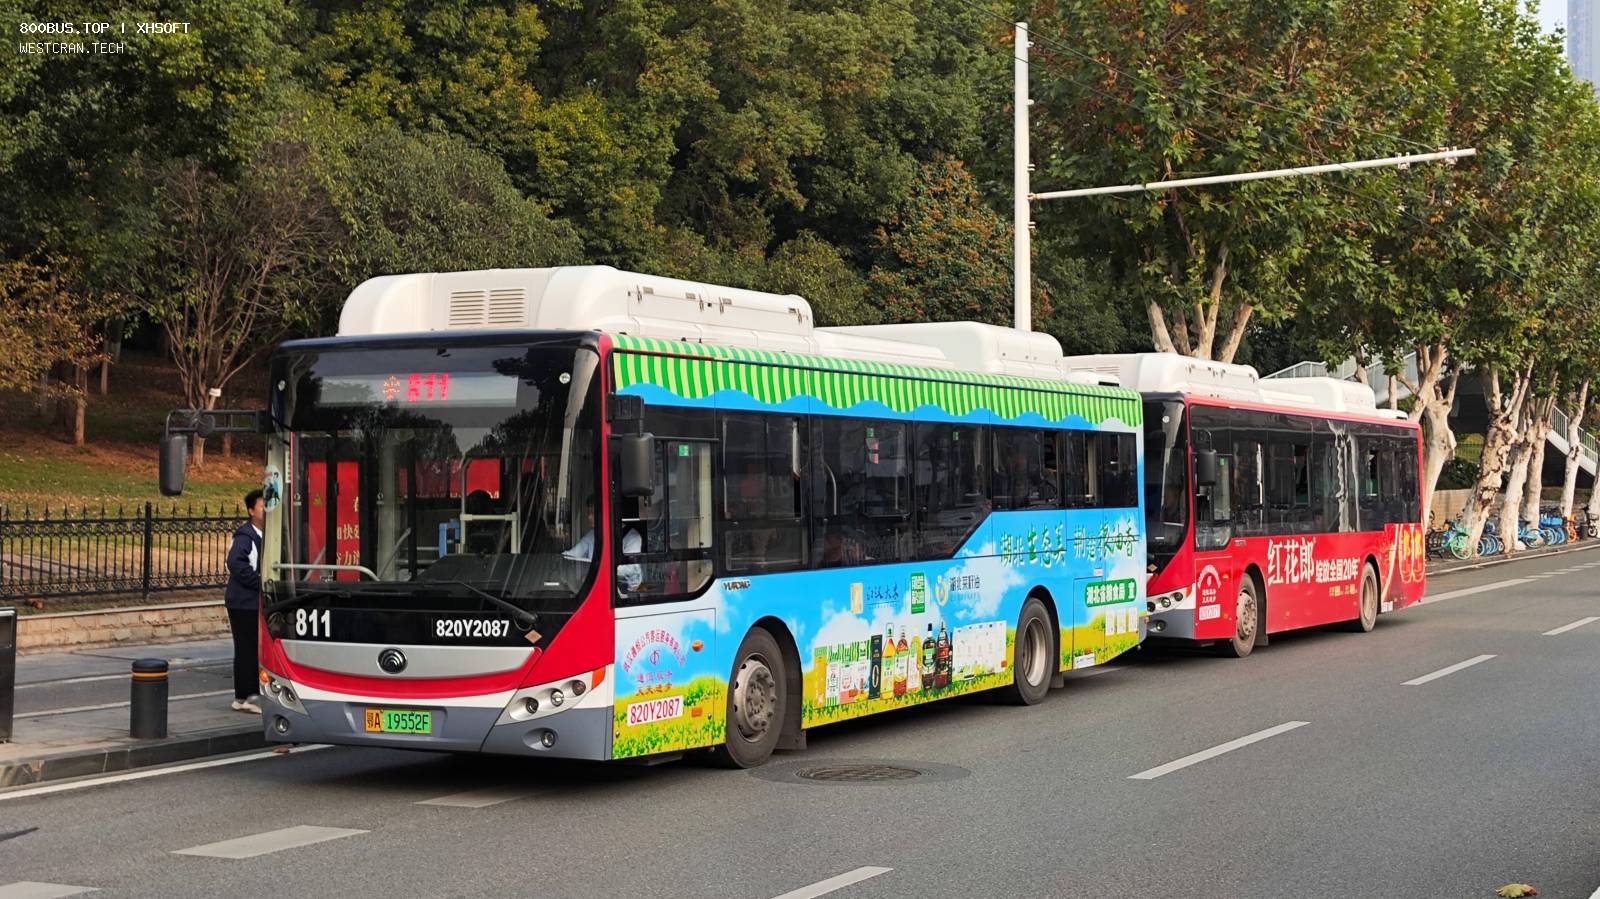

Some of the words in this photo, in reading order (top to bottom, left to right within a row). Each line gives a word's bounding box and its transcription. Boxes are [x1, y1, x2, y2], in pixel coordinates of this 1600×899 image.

[1267, 536, 1316, 586] 红花郎
[1315, 557, 1360, 583] 绽放全国20年
[295, 608, 331, 638] 811
[435, 618, 510, 638] 820Y2087
[386, 712, 429, 731] 19552F
[630, 698, 680, 724] 820Y2087
